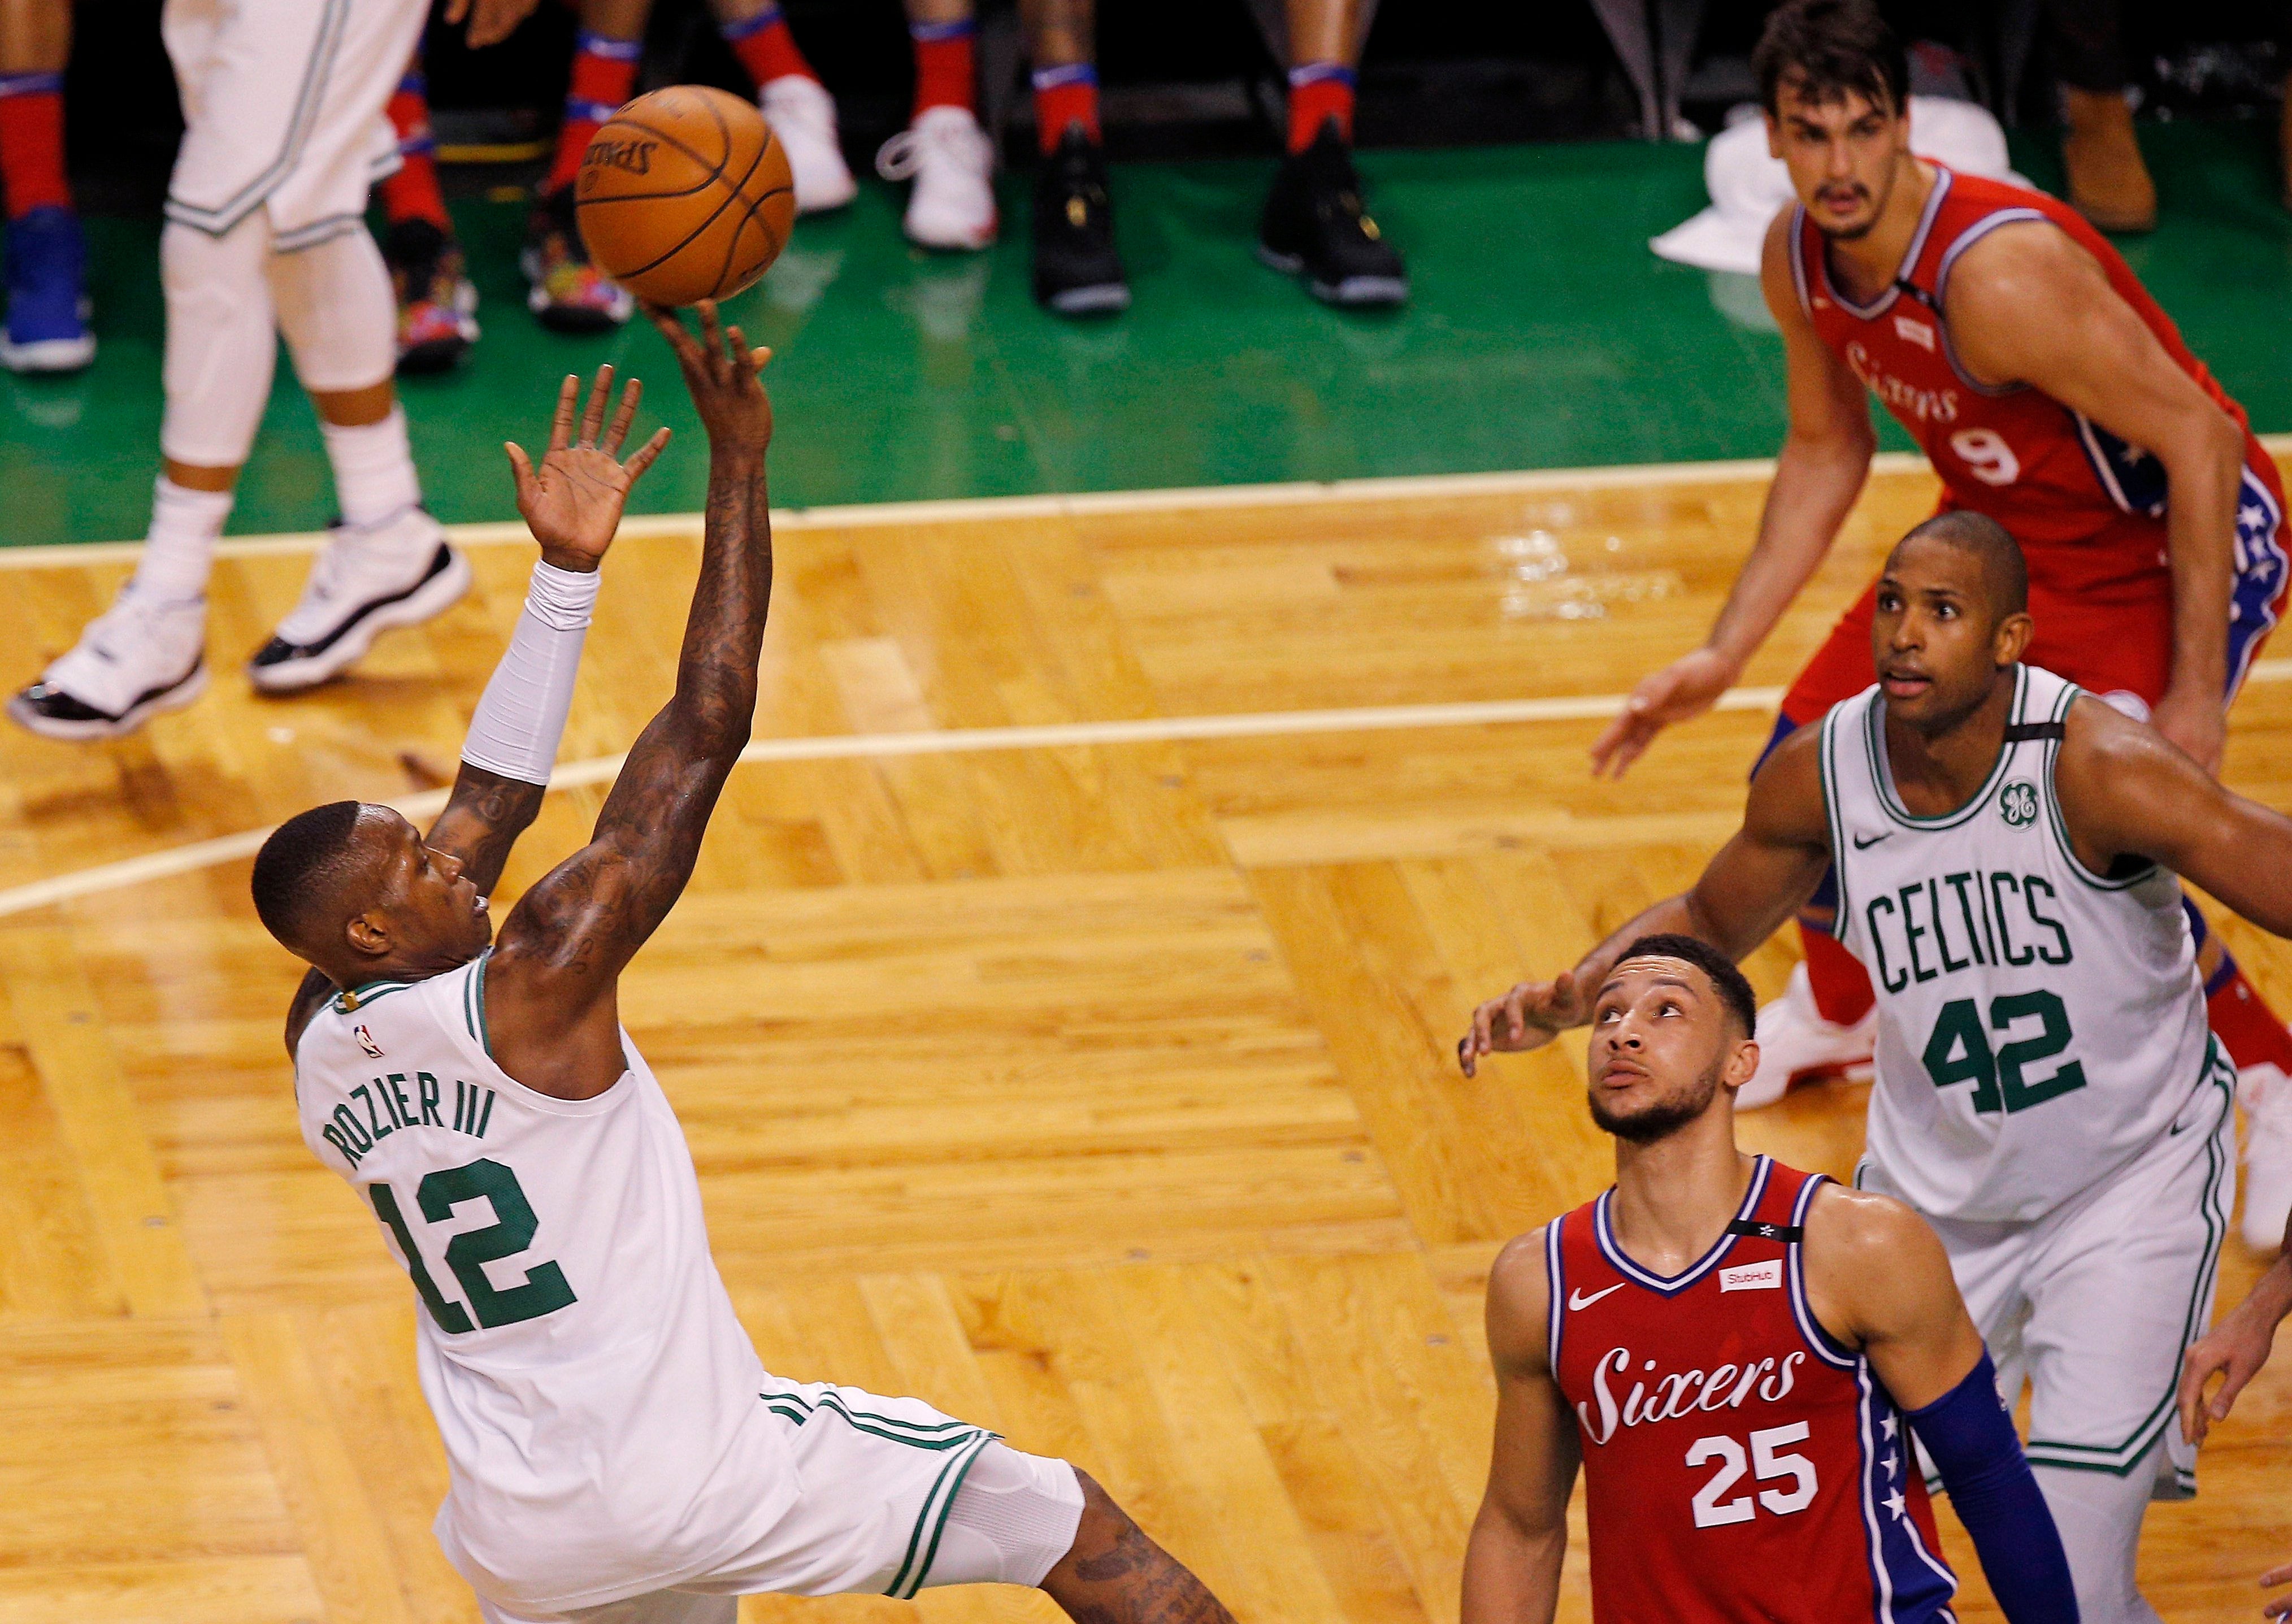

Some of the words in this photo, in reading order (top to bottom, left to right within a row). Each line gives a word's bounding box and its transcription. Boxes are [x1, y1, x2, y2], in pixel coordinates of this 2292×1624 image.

[1951, 427, 2020, 487] 9
[1866, 871, 2073, 993] CELTICS
[1922, 989, 2087, 1114] 42
[323, 1070, 444, 1171] ROZIER
[453, 1079, 496, 1139] III
[369, 1157, 578, 1334] 12
[1577, 1347, 1806, 1445] Sixers
[1684, 1420, 1819, 1529] 25
